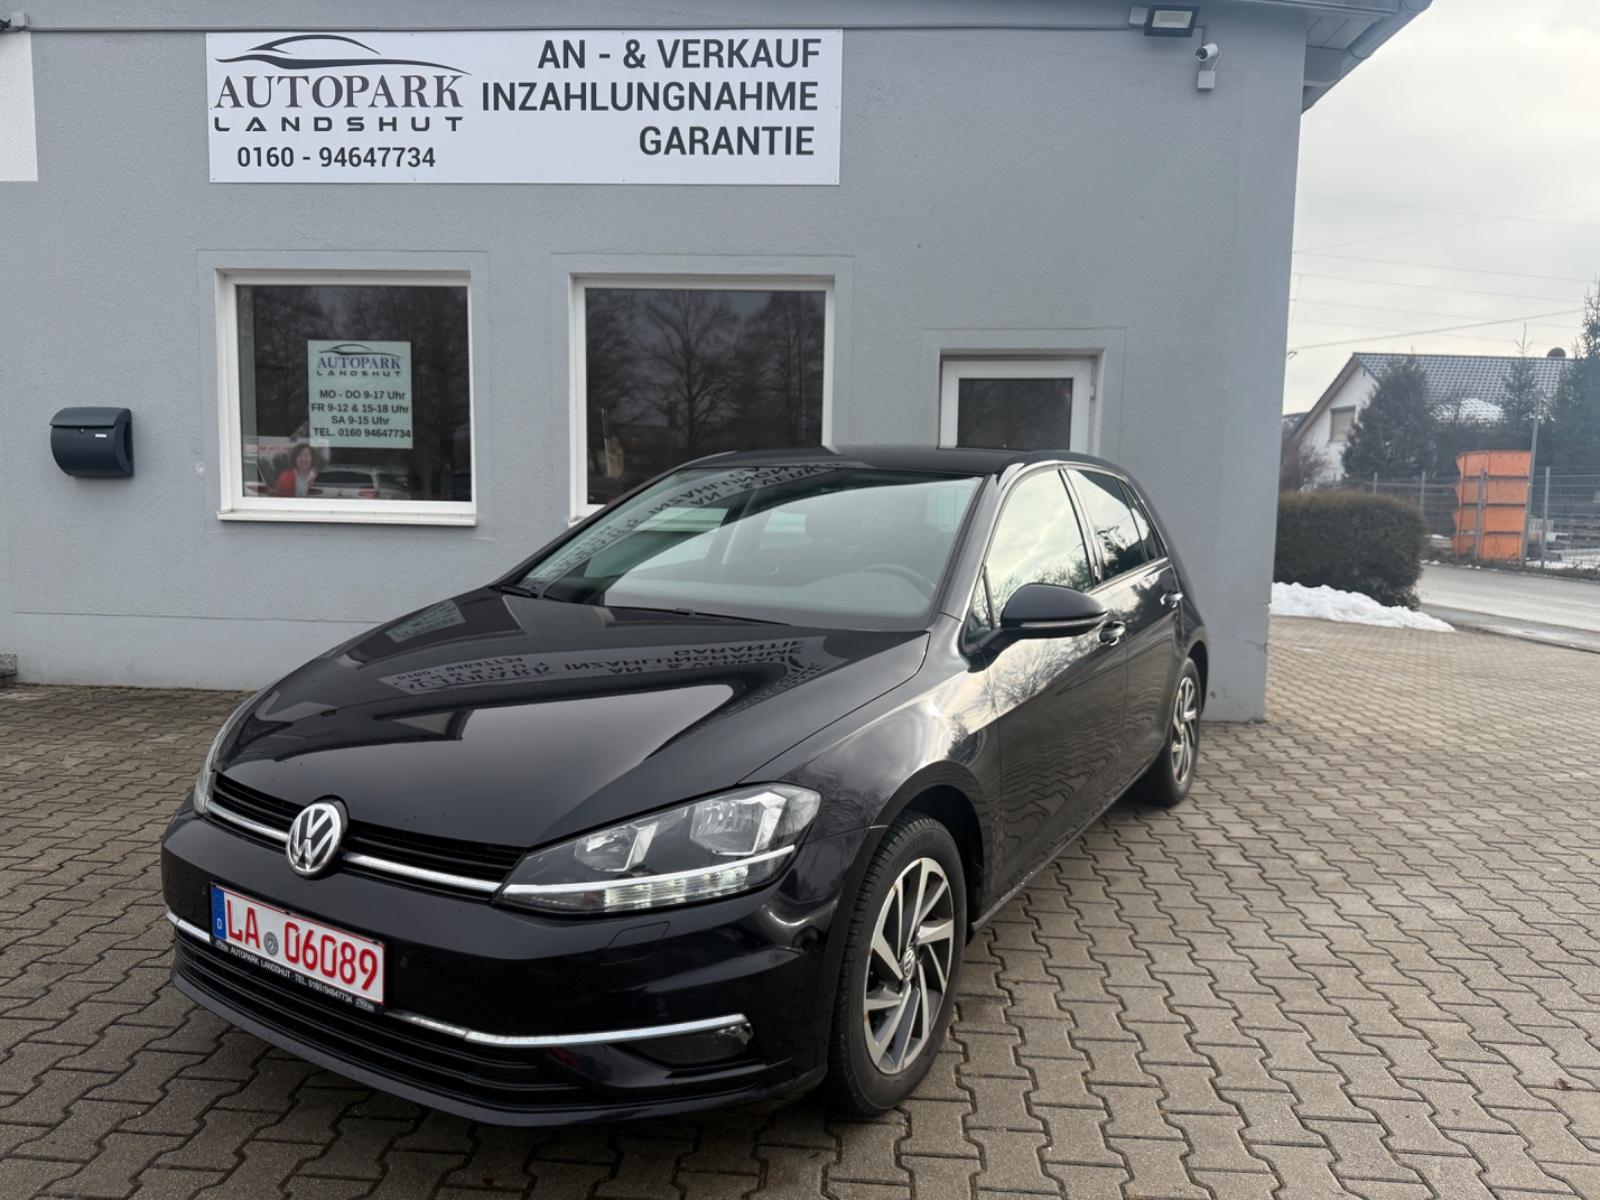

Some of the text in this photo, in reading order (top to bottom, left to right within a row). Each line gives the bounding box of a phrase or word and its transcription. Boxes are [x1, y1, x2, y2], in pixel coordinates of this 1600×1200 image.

[537, 39, 586, 69] AN
[622, 39, 646, 69] &
[656, 38, 822, 69] VERKAUF
[214, 74, 464, 108] AUTOPARK
[481, 81, 818, 112] INZAHLUNGNAHME
[214, 116, 463, 132] LANDSHUT
[639, 126, 815, 156] GARANTIE
[237, 147, 294, 167] 0160
[318, 147, 436, 167] 94647734
[317, 357, 401, 369] AUTOPARK
[320, 390, 336, 399] MO
[346, 390, 360, 399] DO
[364, 390, 384, 400] 9-17
[387, 391, 406, 400] Uhr
[311, 403, 410, 413] FR 9-12 & 15-18 Uhr
[331, 416, 390, 425] SA 9-15 Uhr
[338, 428, 362, 437] 0160
[364, 428, 411, 438] 94647734
[227, 899, 260, 949] LA
[284, 921, 378, 992] 06089
[230, 946, 260, 966] AUTOPARK
